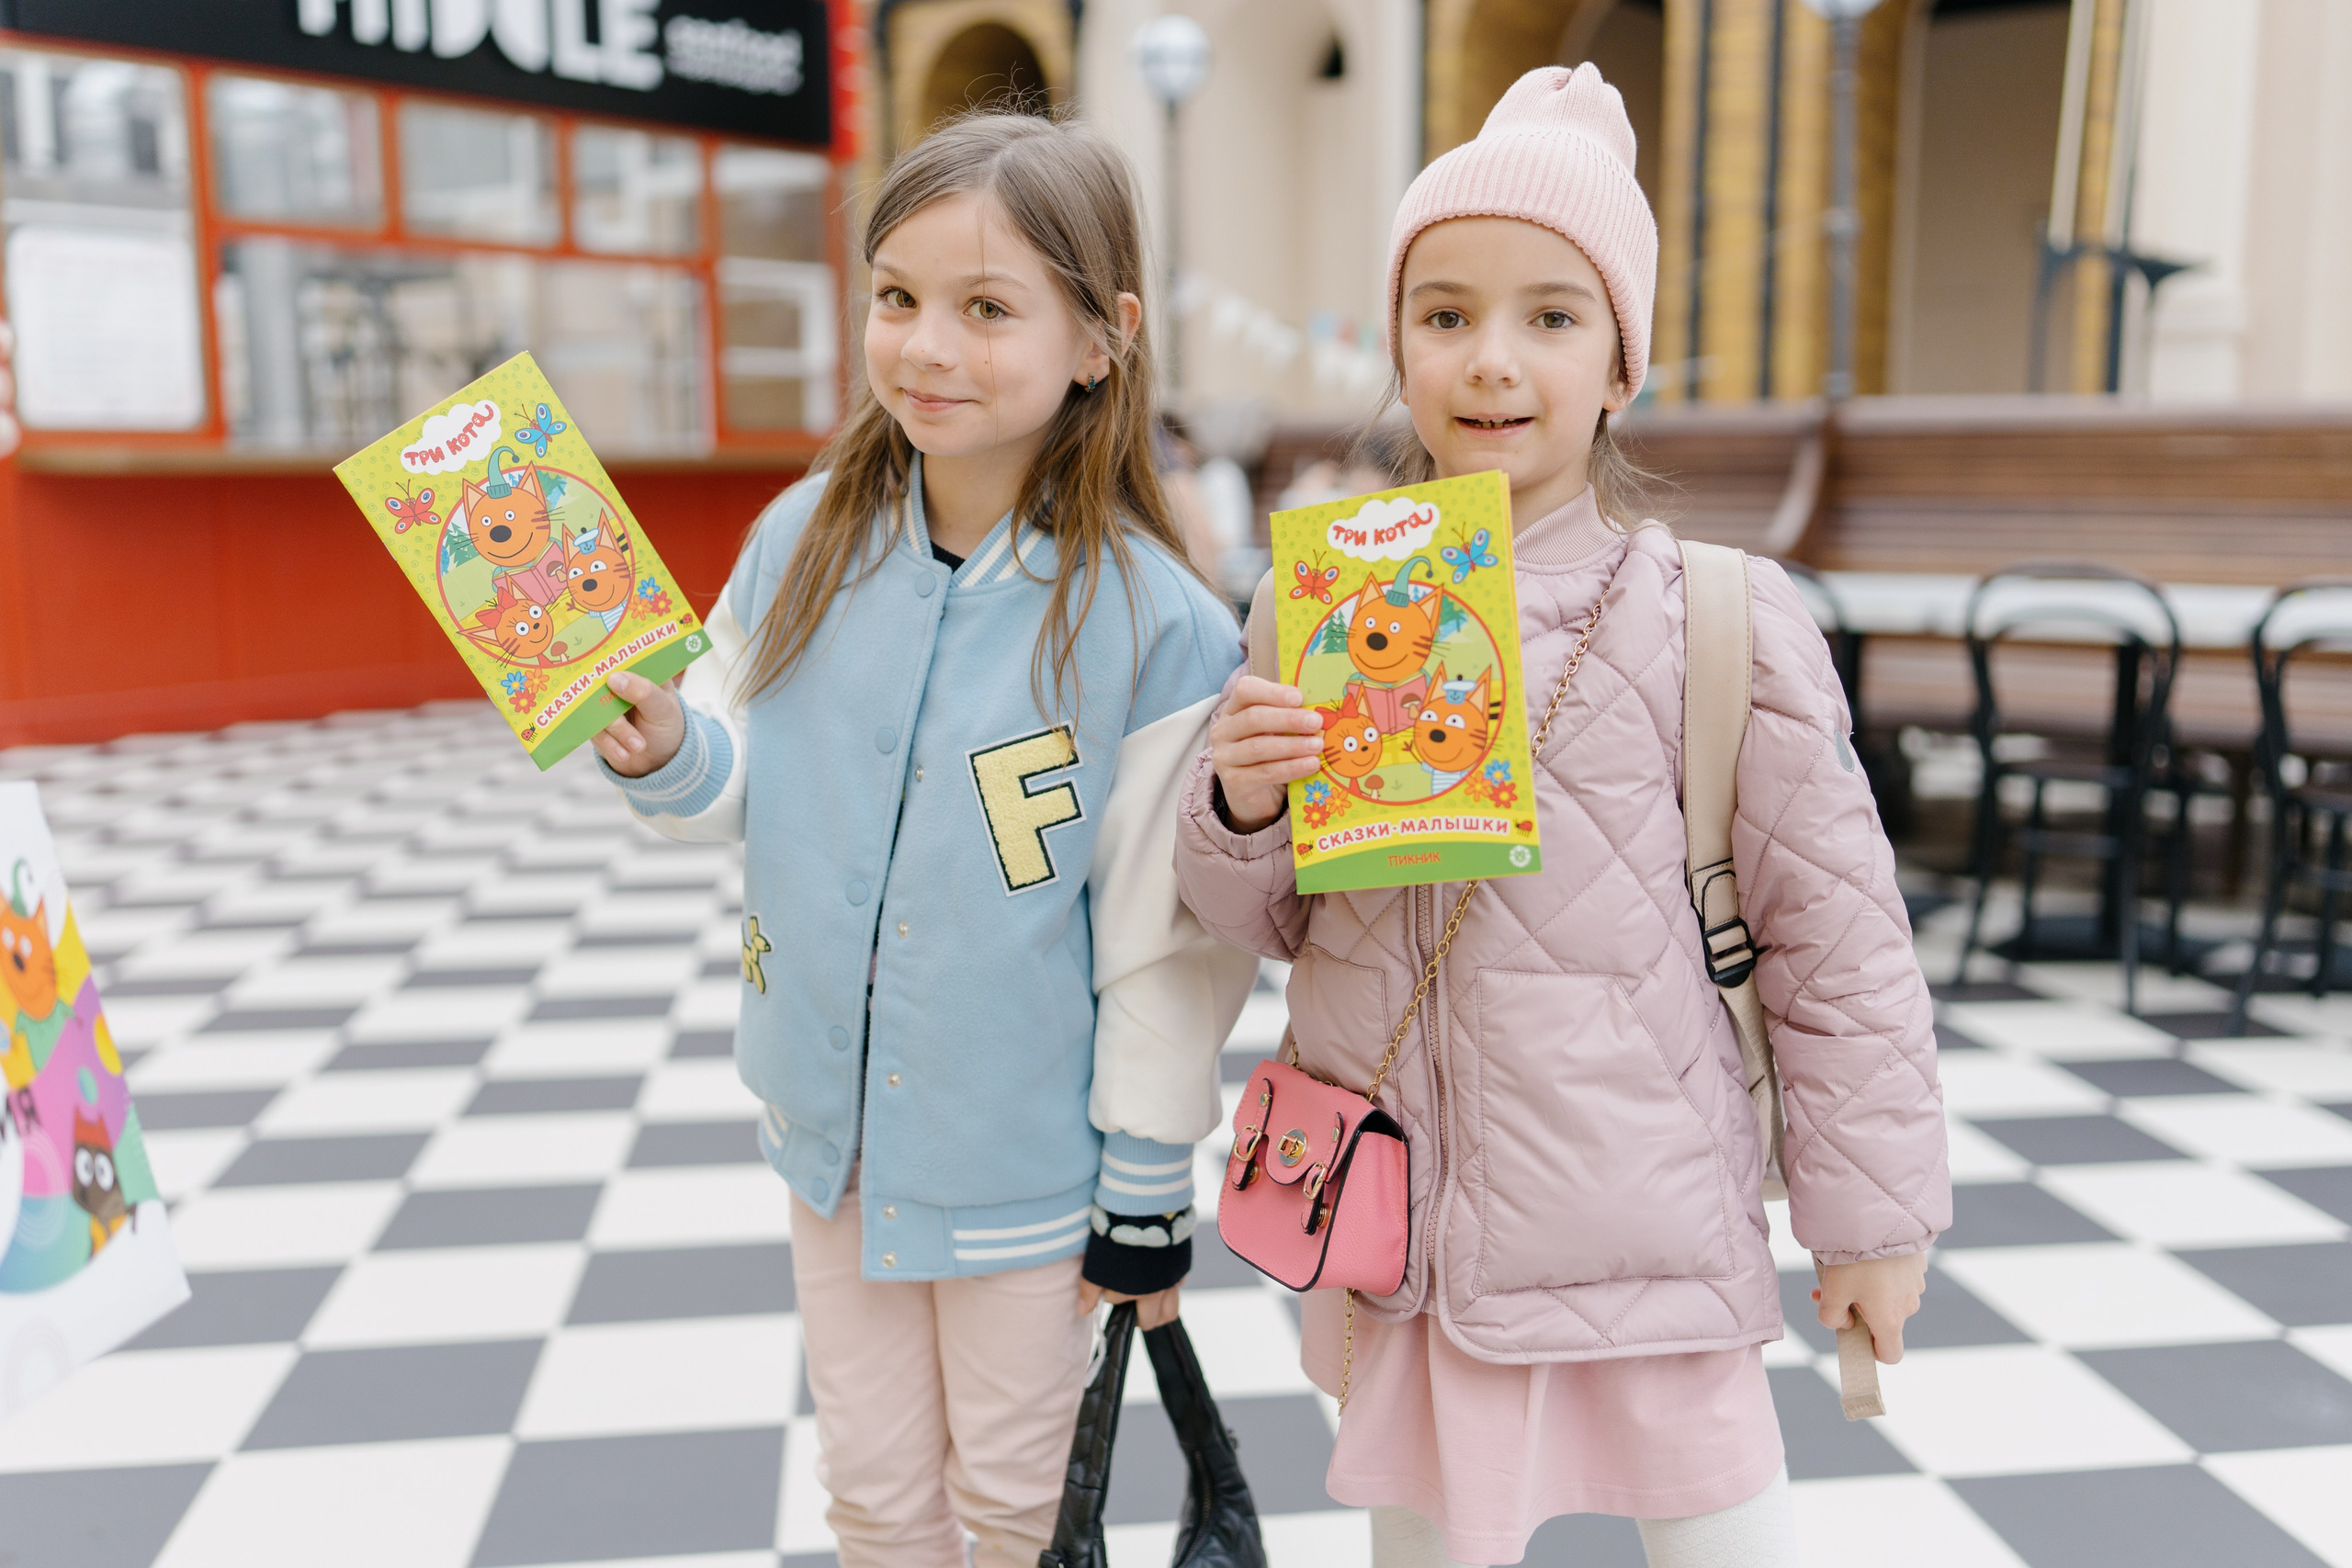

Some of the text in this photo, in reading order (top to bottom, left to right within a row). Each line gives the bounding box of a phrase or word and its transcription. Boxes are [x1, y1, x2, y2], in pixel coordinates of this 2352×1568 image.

[404, 446, 445, 466] ТРИ
[1333, 525, 1367, 547] ТРИ
[965, 720, 1087, 897] F
[1387, 852, 1441, 868] ПИКНИК
